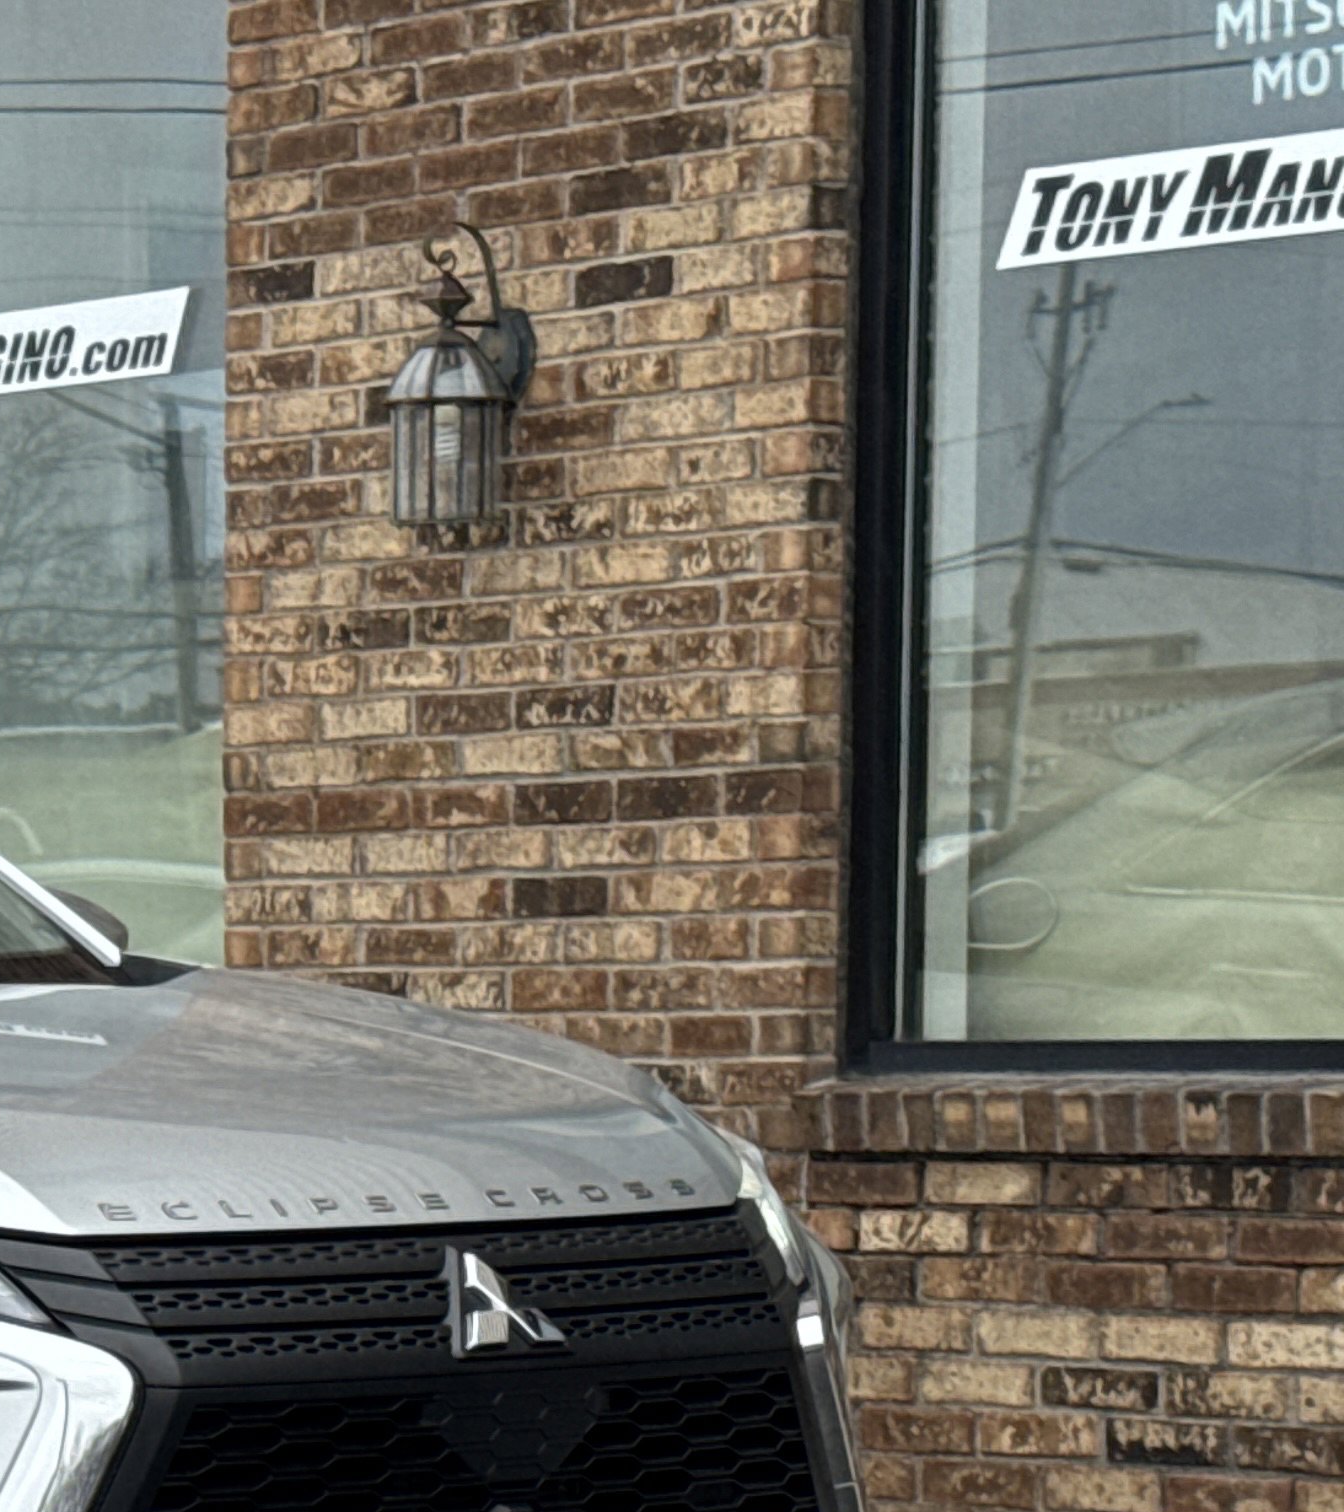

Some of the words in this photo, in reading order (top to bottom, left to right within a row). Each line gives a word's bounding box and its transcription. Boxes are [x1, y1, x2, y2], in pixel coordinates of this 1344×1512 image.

[1215, 0, 1344, 50] MITS
[1179, 147, 1344, 238] MAN
[96, 1192, 451, 1222] ECLIPSE
[483, 1178, 696, 1208] CROSS
